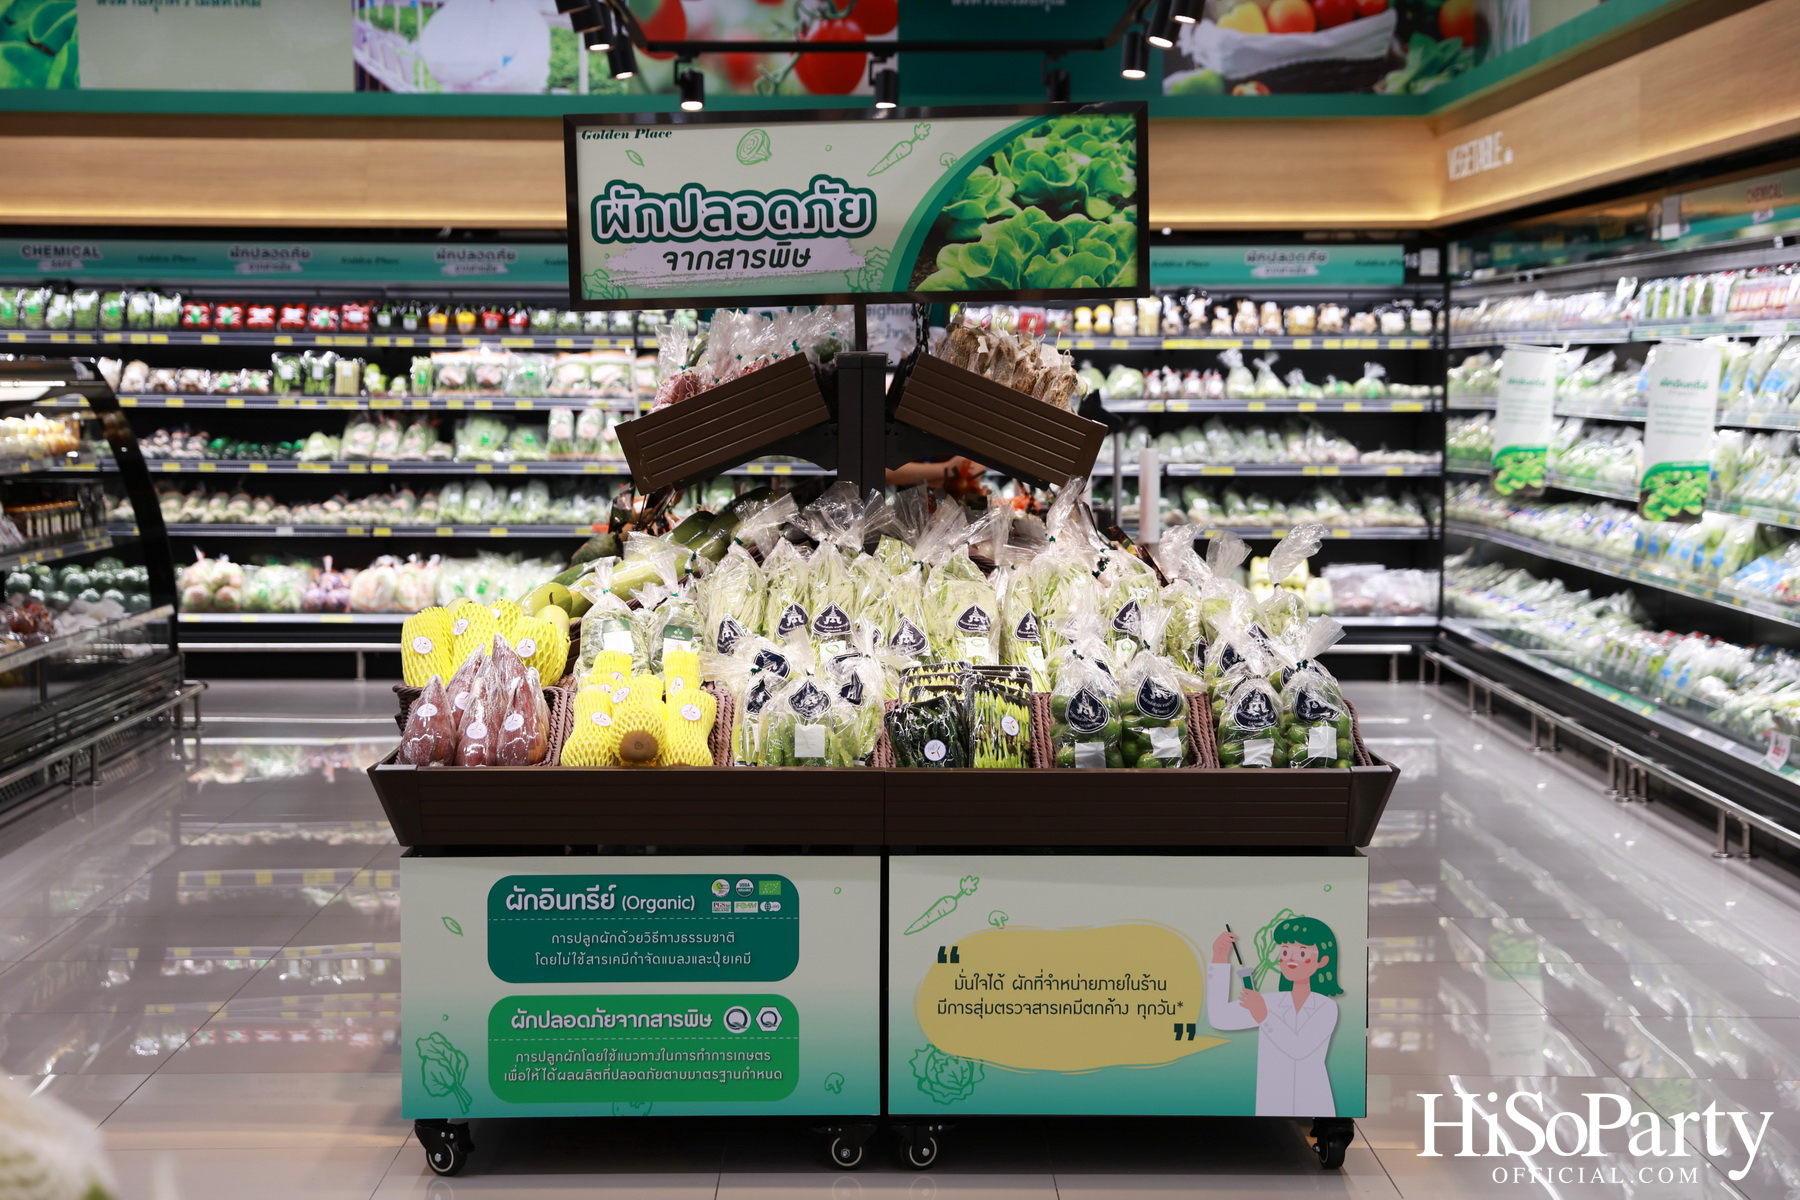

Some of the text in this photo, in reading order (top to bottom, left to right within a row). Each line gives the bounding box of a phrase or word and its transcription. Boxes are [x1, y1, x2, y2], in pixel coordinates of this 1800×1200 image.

[581, 128, 672, 140] Golden Place
[597, 180, 872, 240] ผักปลอดภัย
[20, 244, 101, 259] CHEMICAL
[663, 242, 811, 270] จากสารพิษ
[505, 884, 695, 913] ผักอินทรีย์ (Organic)
[551, 930, 735, 947] การปลูกผักด้วยวิธีทางธรรมชาติ
[535, 951, 751, 967] โดยไม่ใช้สารเคมีกำจัดแมลงและปุ๋ยเคมี
[954, 968, 1167, 991] มั่นใจได้ ผักที่จำหน่ายภายในร้าน
[511, 1007, 712, 1029] ผักปลอดภัยจากสารพิษ
[937, 997, 1129, 1019] มีการสุ่มตรวจสารเคมีตกค้าง
[516, 1047, 771, 1066] การปลูกผักโดยใช้แนวทางในการทำการเกษตร
[504, 1064, 783, 1083] เพื่อให้ได้ผลผลิตที่ปลอดภัยตามมาตรฐานกำหนด
